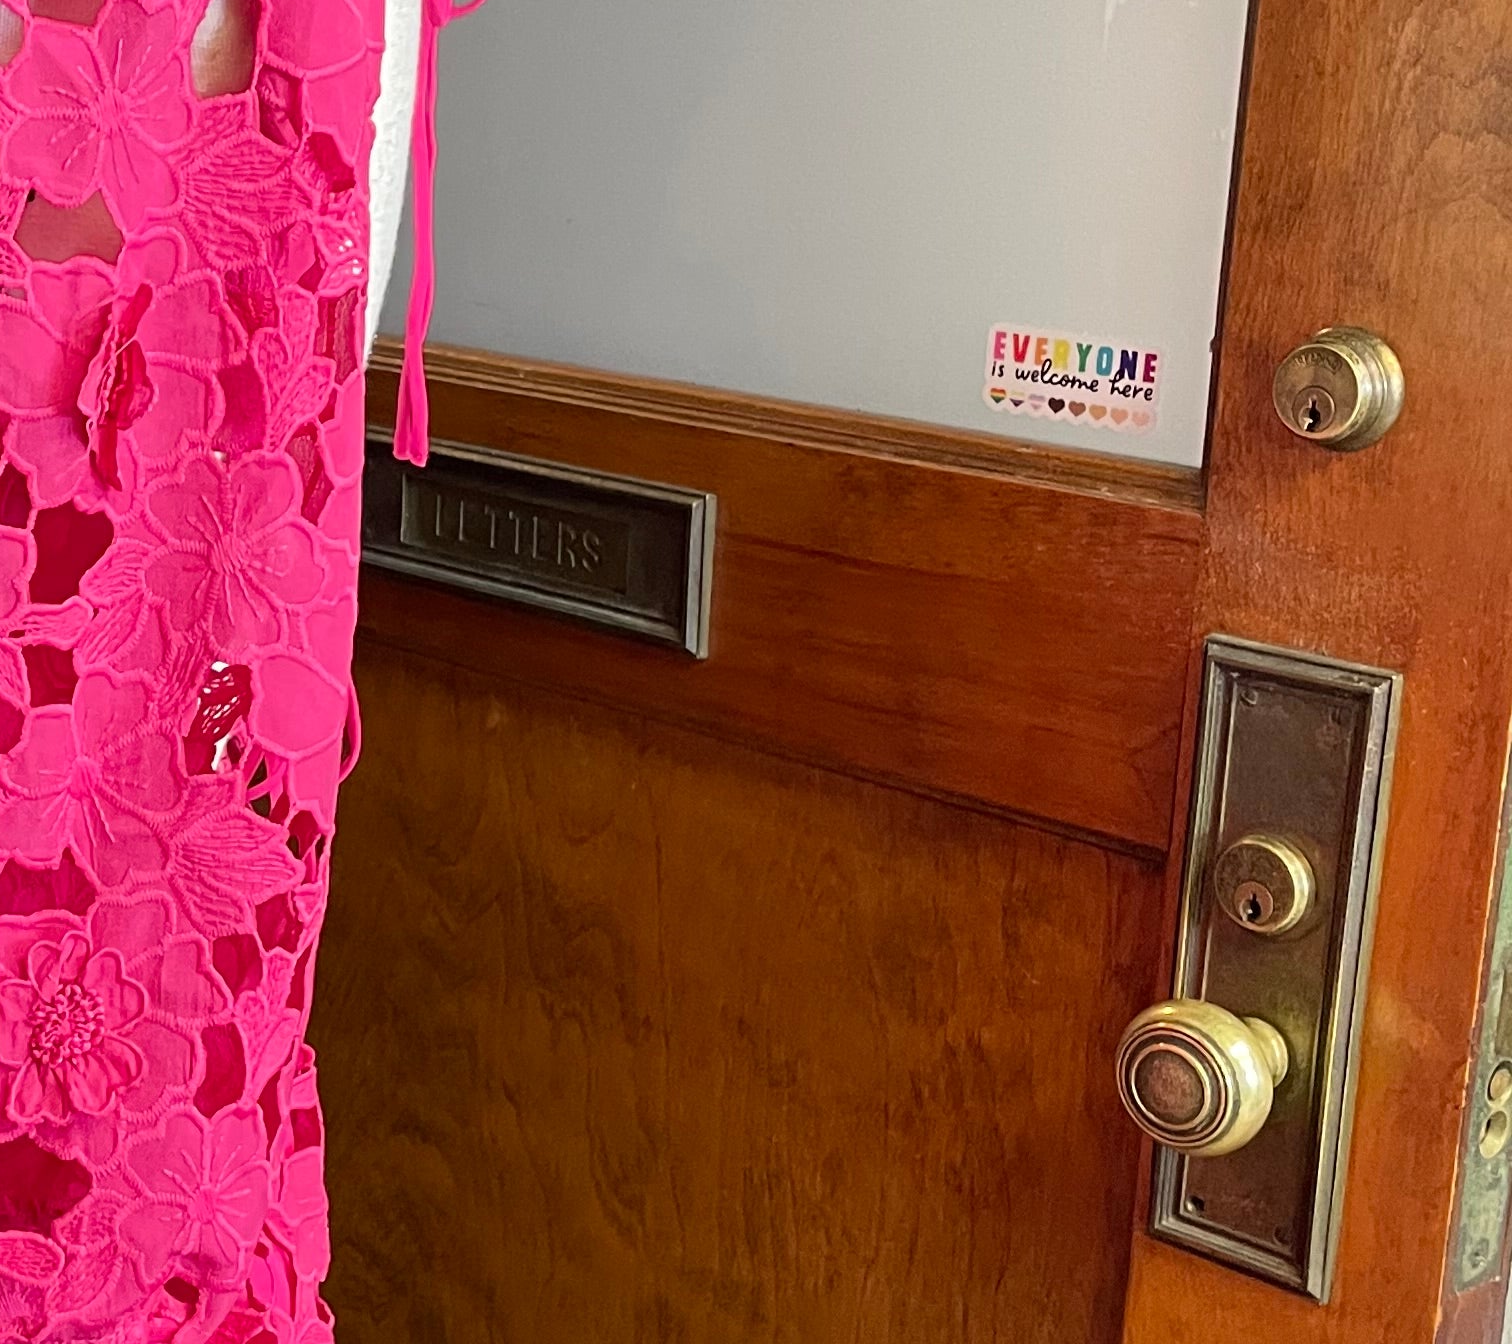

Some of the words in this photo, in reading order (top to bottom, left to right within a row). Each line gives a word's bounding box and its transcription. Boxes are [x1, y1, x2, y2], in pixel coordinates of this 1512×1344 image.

[991, 361, 1004, 378] is
[1015, 358, 1099, 392] welcome
[1109, 369, 1153, 401] here
[993, 331, 1157, 383] EVERYONE
